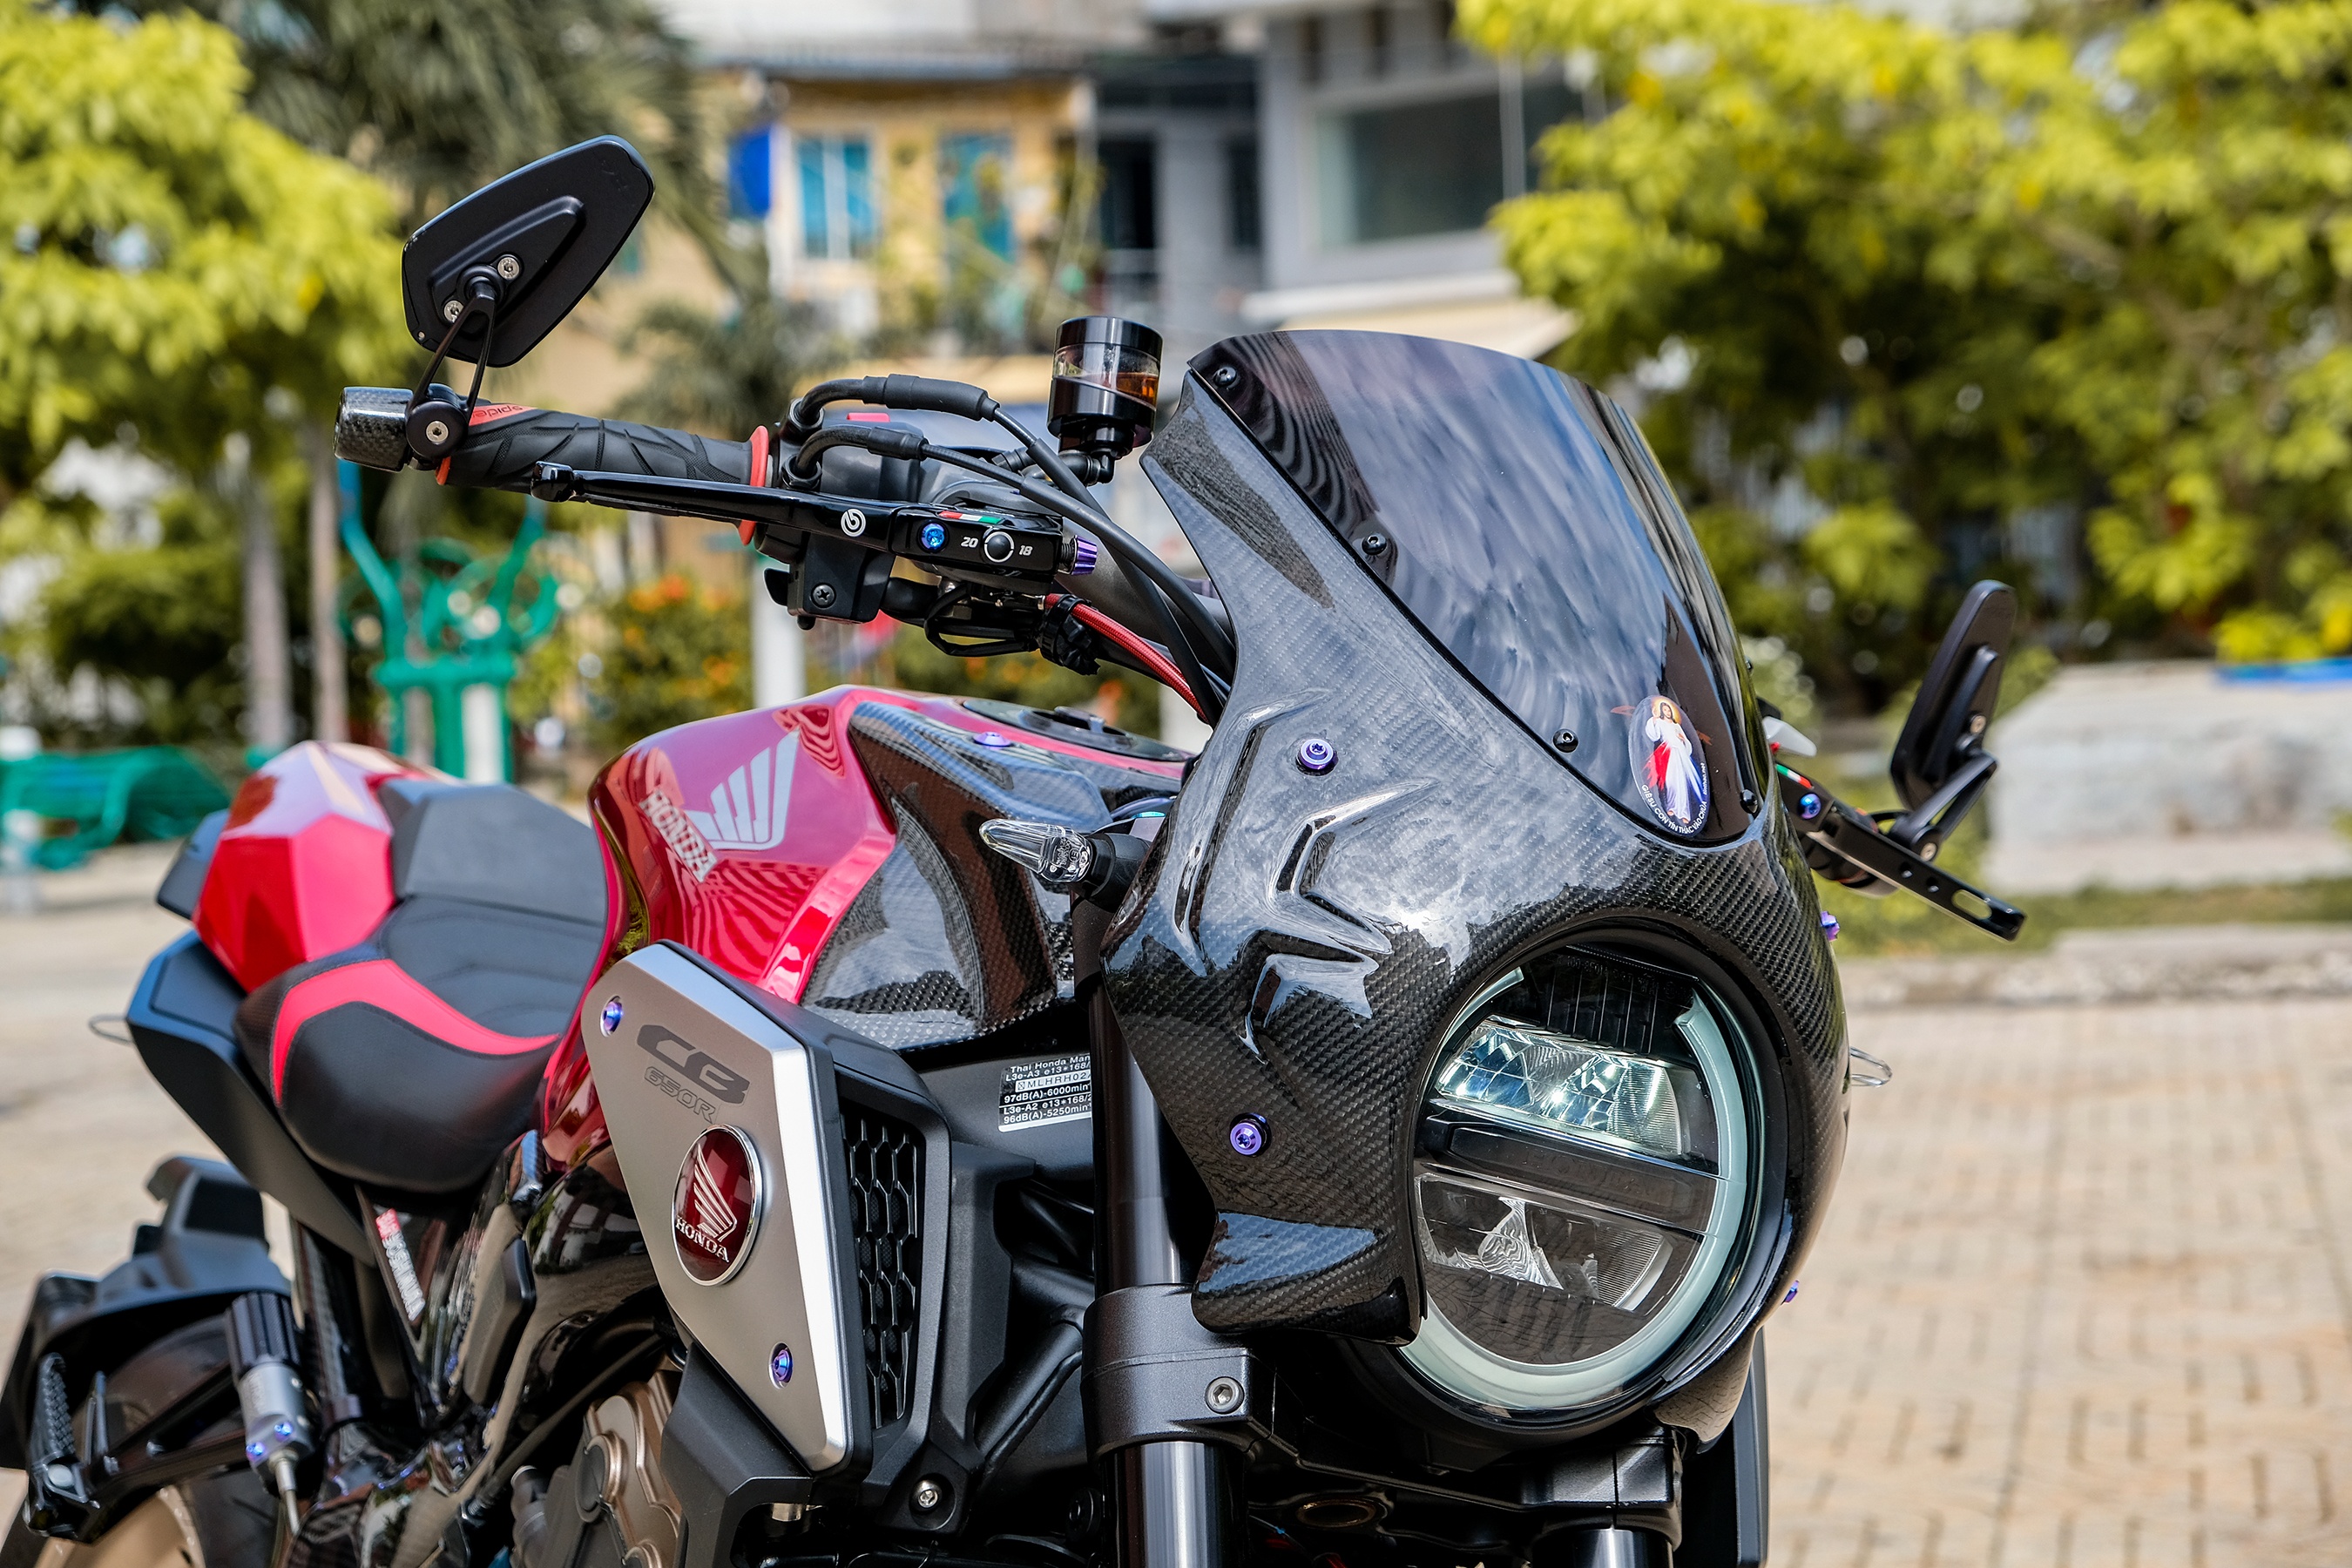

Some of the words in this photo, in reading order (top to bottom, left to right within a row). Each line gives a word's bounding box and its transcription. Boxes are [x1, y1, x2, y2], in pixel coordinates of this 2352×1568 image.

[961, 537, 979, 548] 20
[1018, 545, 1033, 556] 18
[1655, 808, 1668, 824] CON
[639, 787, 719, 883] HONDA
[637, 1024, 750, 1105] CB
[1010, 1064, 1031, 1073] Thai
[1035, 1058, 1066, 1070] Honda
[1005, 1070, 1040, 1081] L3e-A3
[644, 1065, 716, 1124] 650R
[1004, 1103, 1038, 1115] L3e-A2
[675, 1215, 730, 1263] HONDA
